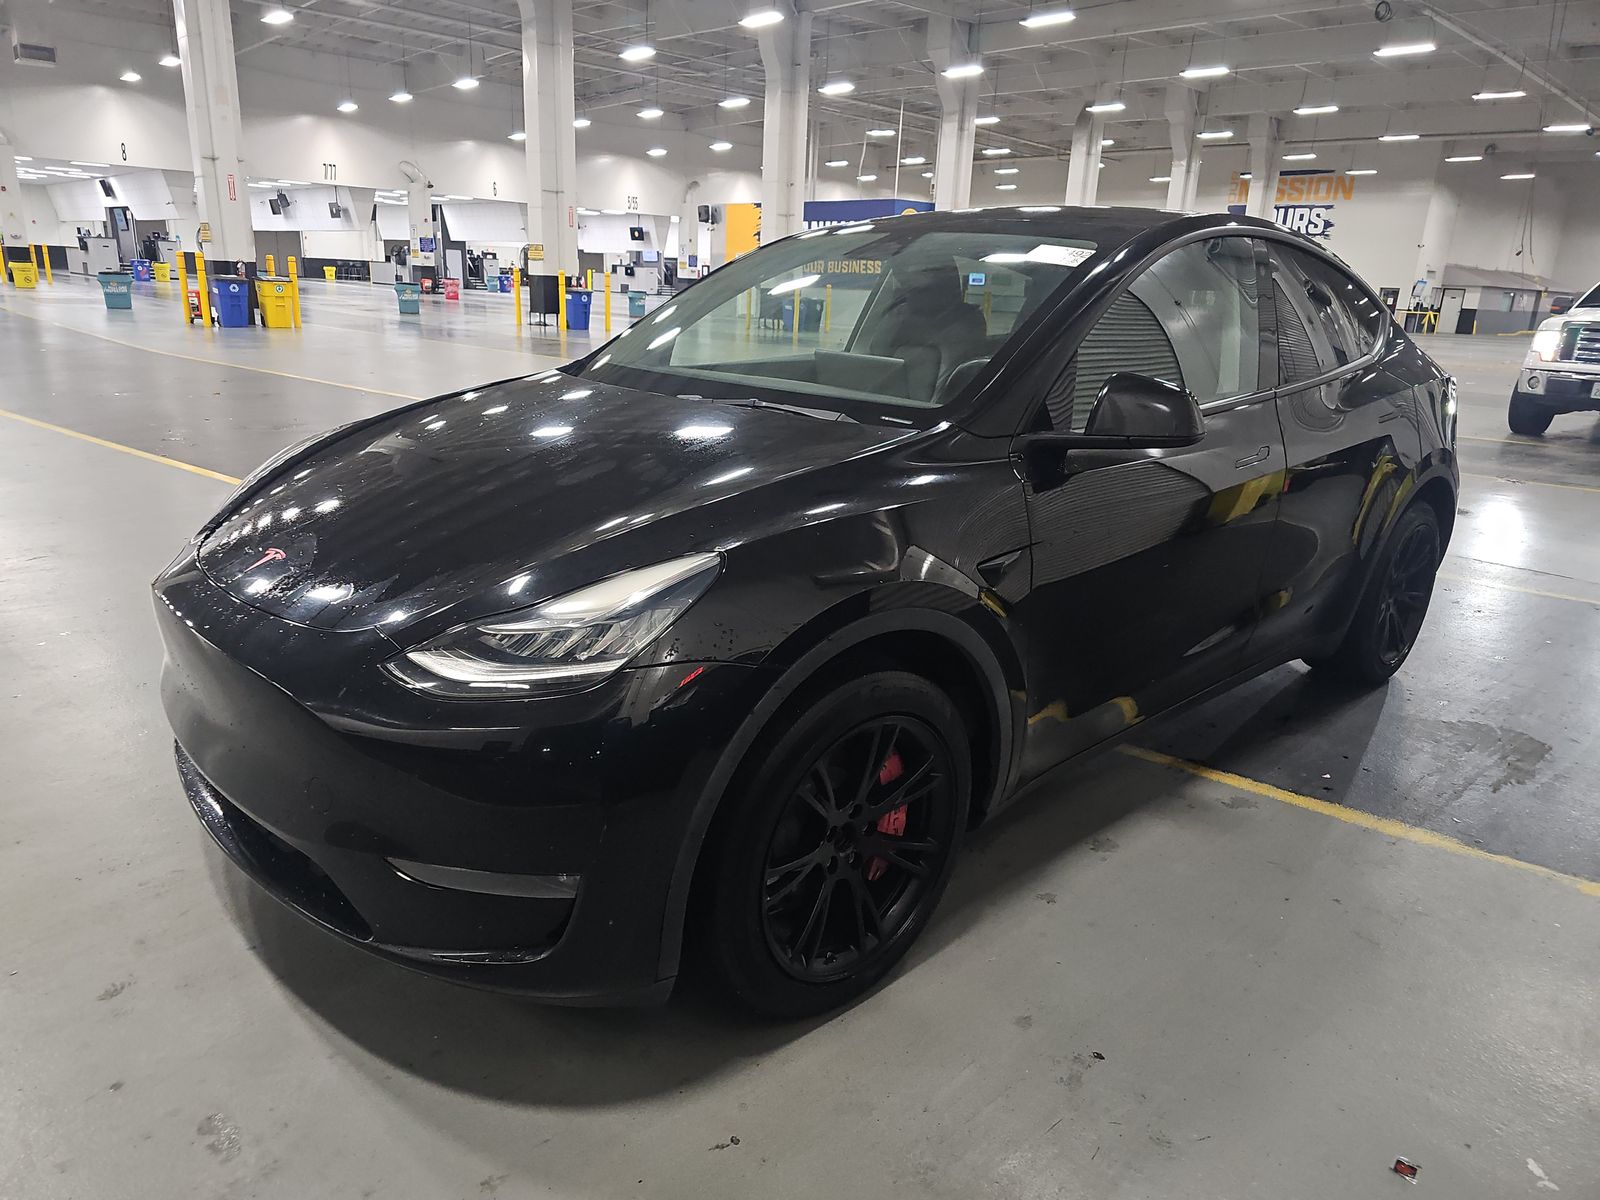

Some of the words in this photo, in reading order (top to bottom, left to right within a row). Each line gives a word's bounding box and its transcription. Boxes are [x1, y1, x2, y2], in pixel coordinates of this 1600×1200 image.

[121, 142, 128, 162] 8
[492, 181, 498, 197] 6
[1238, 176, 1354, 202] MSSION
[827, 260, 882, 274] BUSINESS
